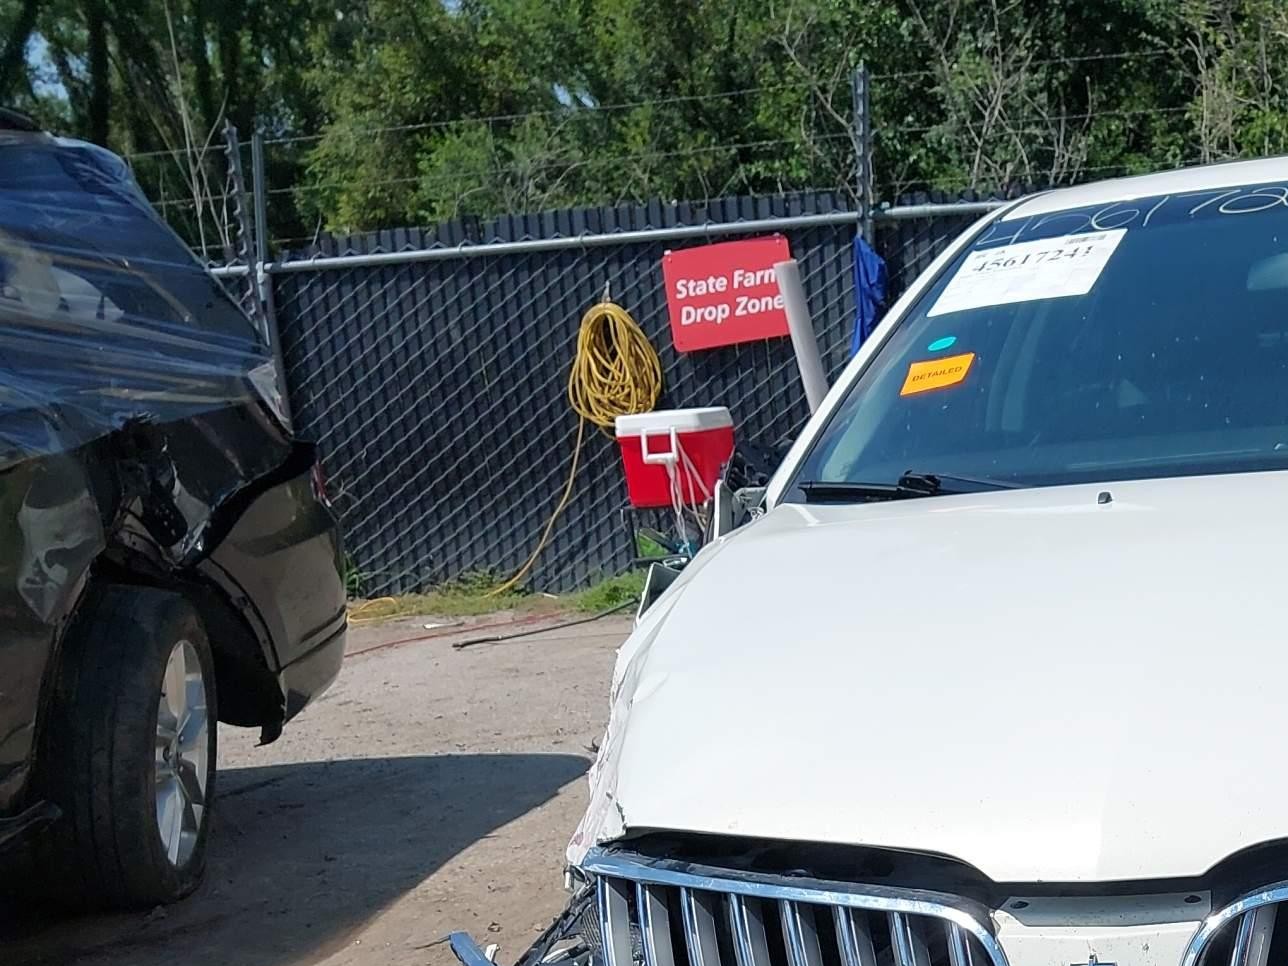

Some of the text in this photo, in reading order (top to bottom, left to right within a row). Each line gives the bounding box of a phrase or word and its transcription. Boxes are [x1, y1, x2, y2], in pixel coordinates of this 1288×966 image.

[971, 244, 1094, 273] 45617241
[676, 276, 728, 299] State
[681, 294, 785, 326] Drop Zone
[911, 366, 963, 382] DETAILED
